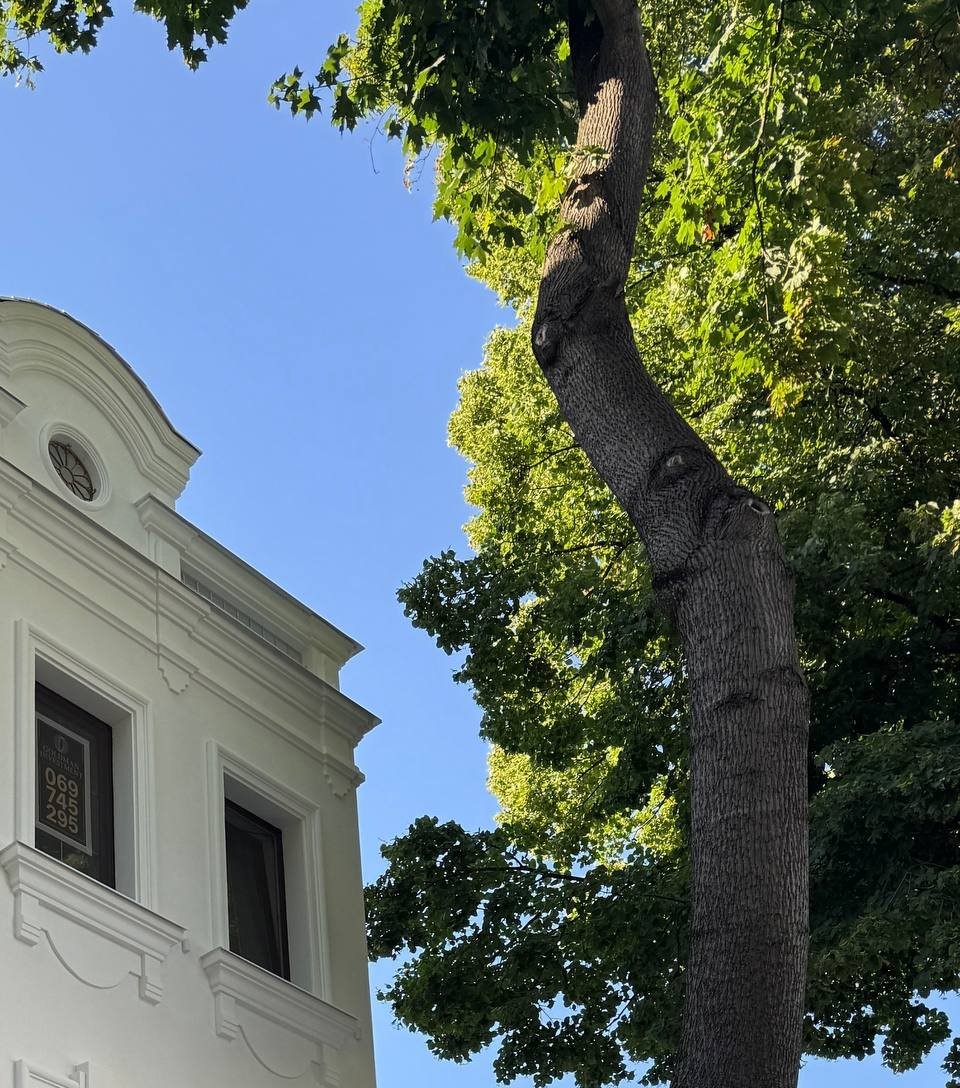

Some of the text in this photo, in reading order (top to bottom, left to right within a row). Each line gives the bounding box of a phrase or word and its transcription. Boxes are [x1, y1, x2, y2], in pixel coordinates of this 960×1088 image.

[45, 767, 78, 798] 069
[47, 785, 78, 815] 745
[47, 804, 78, 834] 295
